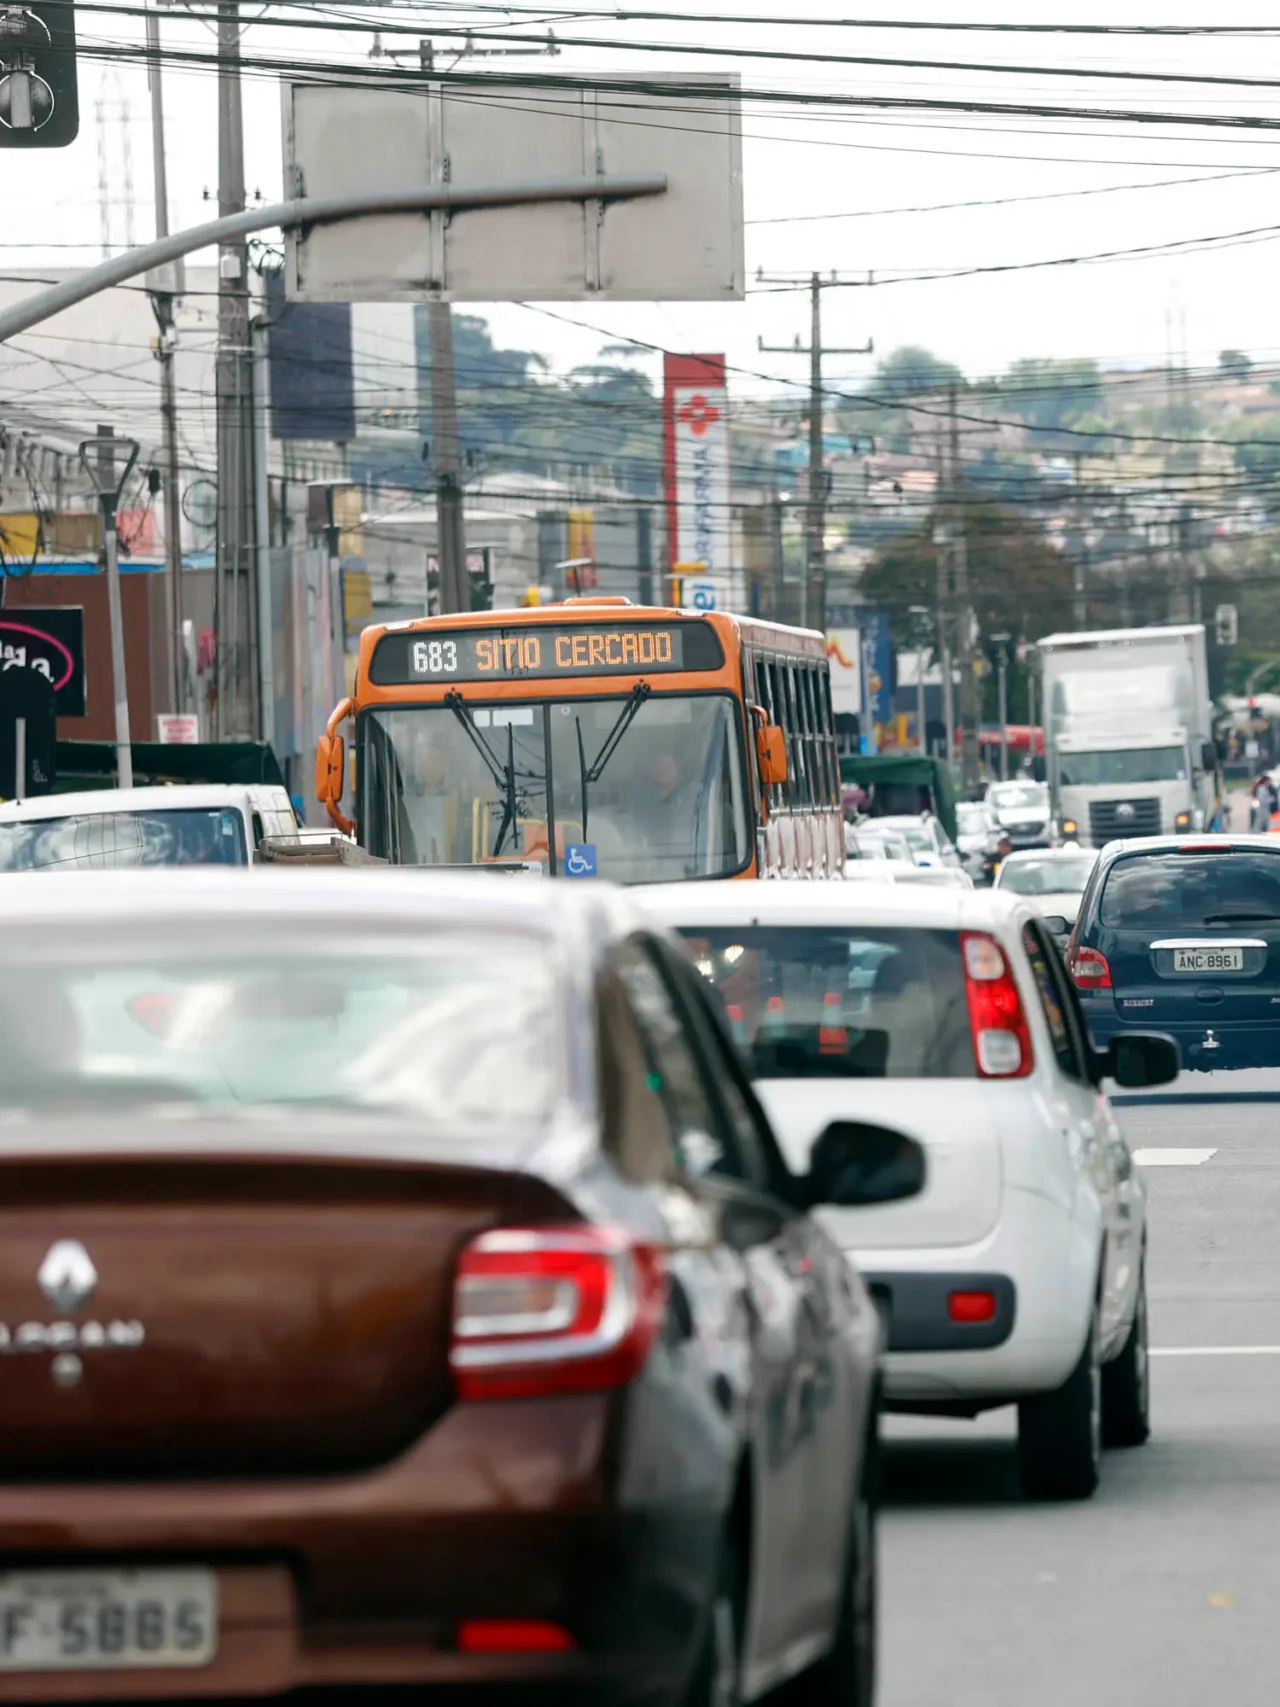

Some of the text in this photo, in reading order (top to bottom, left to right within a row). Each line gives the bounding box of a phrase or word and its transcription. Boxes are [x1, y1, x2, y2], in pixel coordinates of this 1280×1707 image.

[413, 632, 672, 672] 683 SITIO CERCADO
